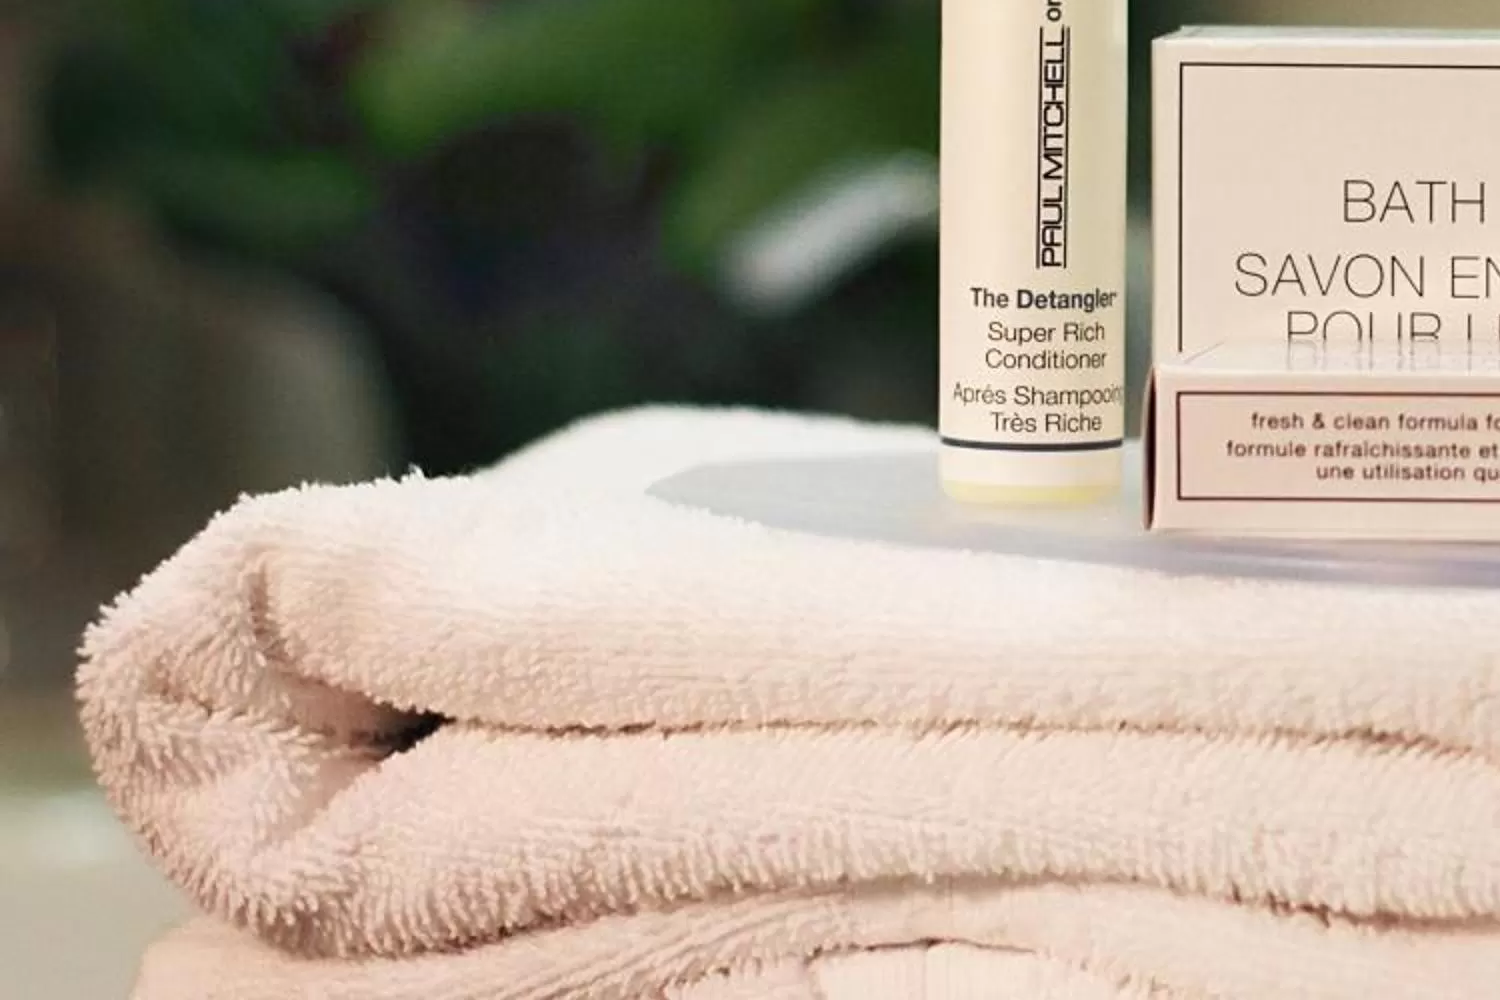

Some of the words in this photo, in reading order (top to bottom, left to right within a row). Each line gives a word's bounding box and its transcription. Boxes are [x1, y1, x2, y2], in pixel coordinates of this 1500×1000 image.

[1043, 25, 1065, 180] MITCHELL
[1342, 179, 1485, 223] BATH
[1041, 186, 1063, 266] PAUL
[1234, 252, 1425, 298] SAVON
[971, 288, 1009, 308] The
[1017, 288, 1117, 312] Detangler
[988, 321, 1056, 345] Super
[1063, 322, 1105, 342] Rich
[985, 348, 1107, 369] Conditioner
[1013, 384, 1123, 408] Shampooin
[991, 411, 1037, 432] Très
[1044, 413, 1101, 433] Riche
[1251, 412, 1305, 430] fresh
[1311, 412, 1326, 430] &
[1333, 413, 1390, 430] clean
[1398, 413, 1478, 431] formula
[1226, 440, 1307, 457] formule
[1479, 443, 1498, 460] et
[1315, 466, 1354, 480] une
[1362, 464, 1465, 481] utilisation
